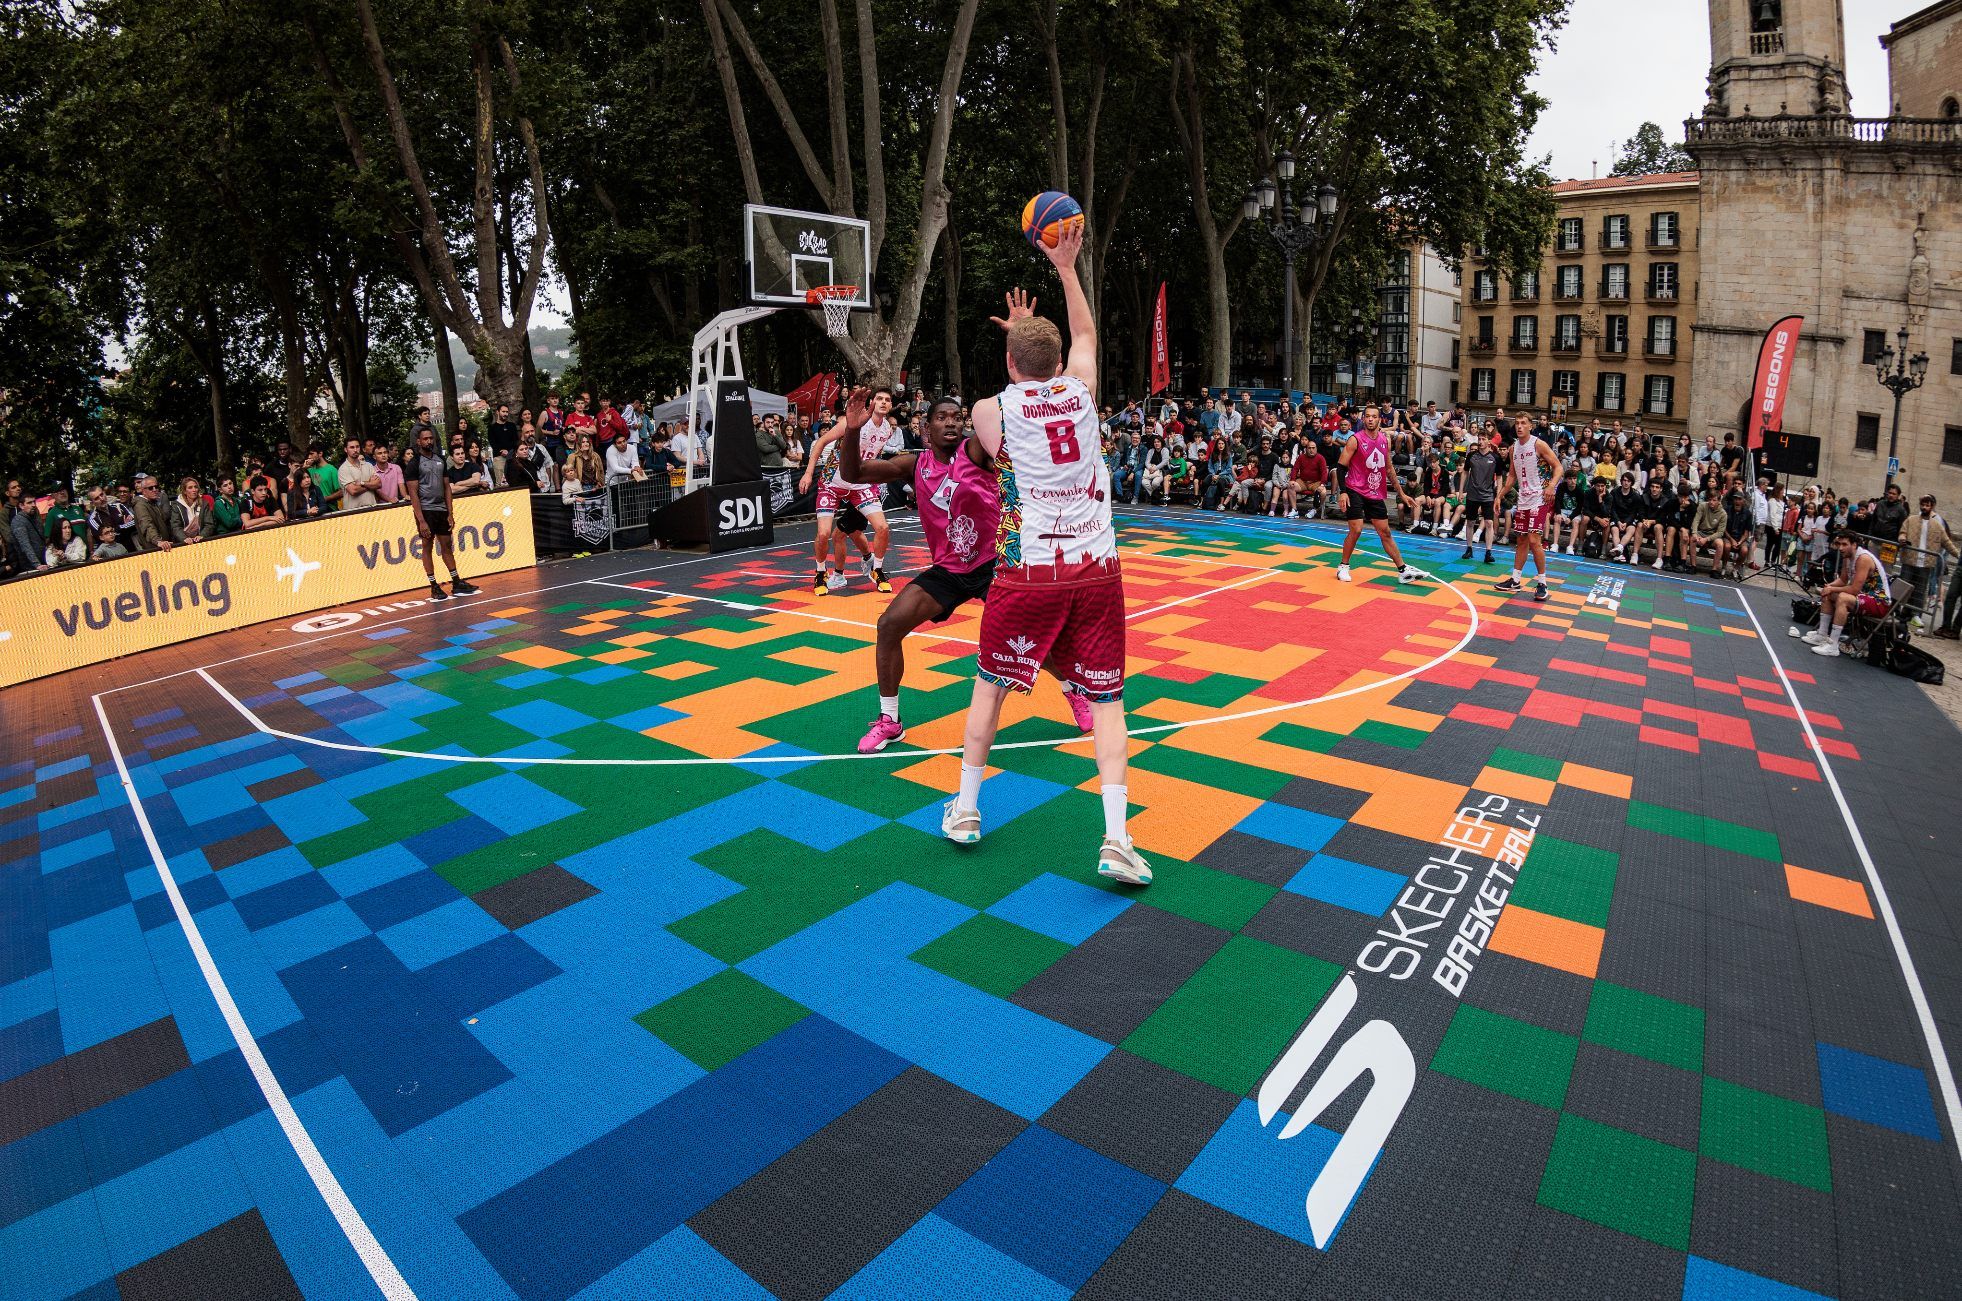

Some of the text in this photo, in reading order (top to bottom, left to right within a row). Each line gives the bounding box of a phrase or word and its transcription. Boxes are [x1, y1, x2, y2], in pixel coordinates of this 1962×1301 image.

[1044, 419, 1080, 465] 8
[1780, 436, 1789, 448] 4
[719, 495, 763, 530] SDI
[1030, 483, 1088, 499] Cervantes
[357, 521, 505, 570] vueng
[52, 570, 231, 637] vueling
[992, 652, 1014, 663] CAJA
[1356, 794, 1509, 980] SKECHERS
[1431, 814, 1542, 998] BASKETBALL
